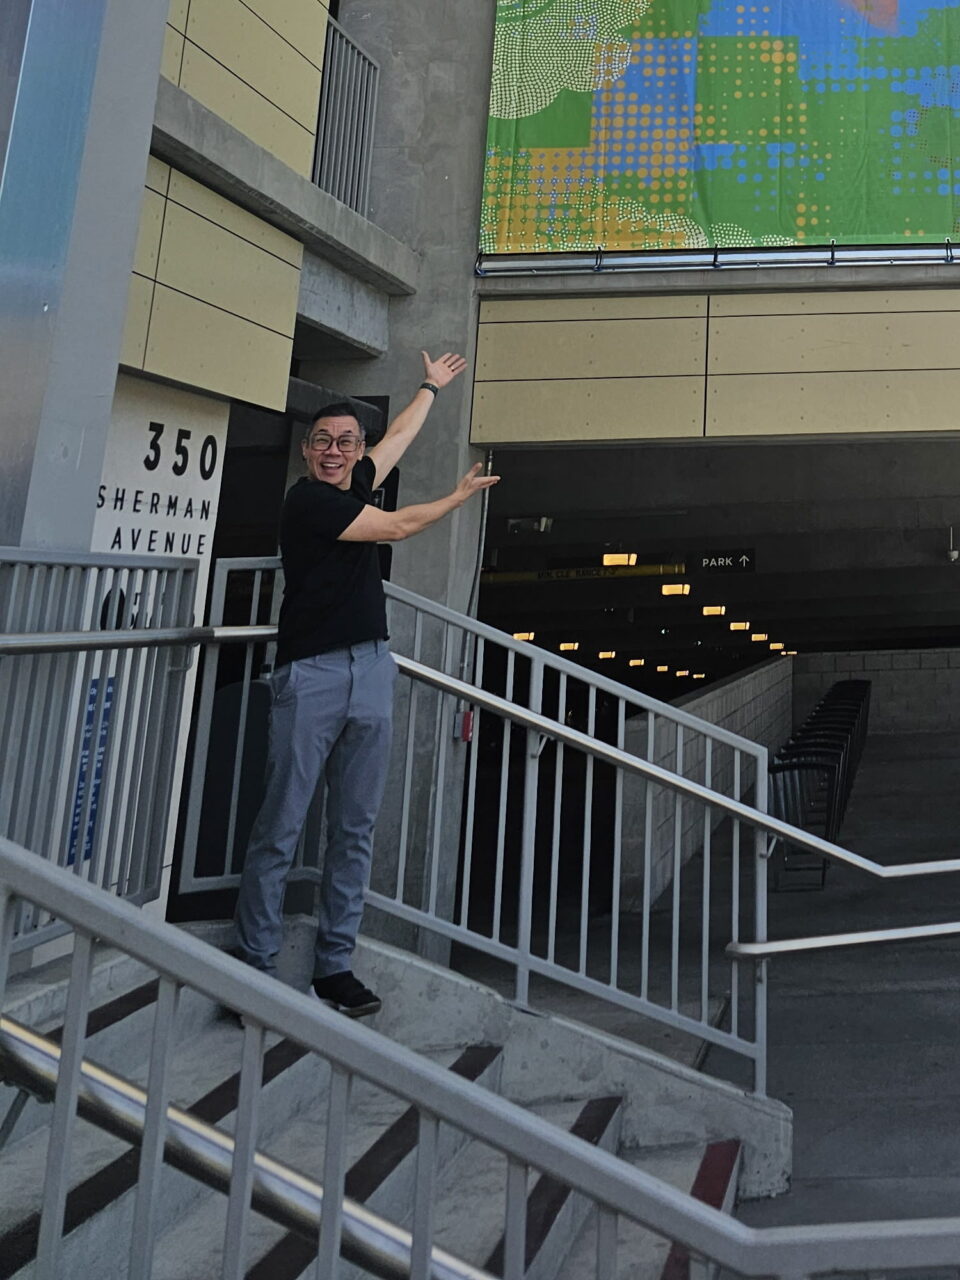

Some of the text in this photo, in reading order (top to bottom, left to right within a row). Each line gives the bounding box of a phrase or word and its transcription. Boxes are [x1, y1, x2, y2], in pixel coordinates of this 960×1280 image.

[143, 421, 218, 481] 350
[97, 485, 211, 521] SHERMAN
[110, 526, 207, 555] AVENUE
[702, 557, 733, 568] PARK
